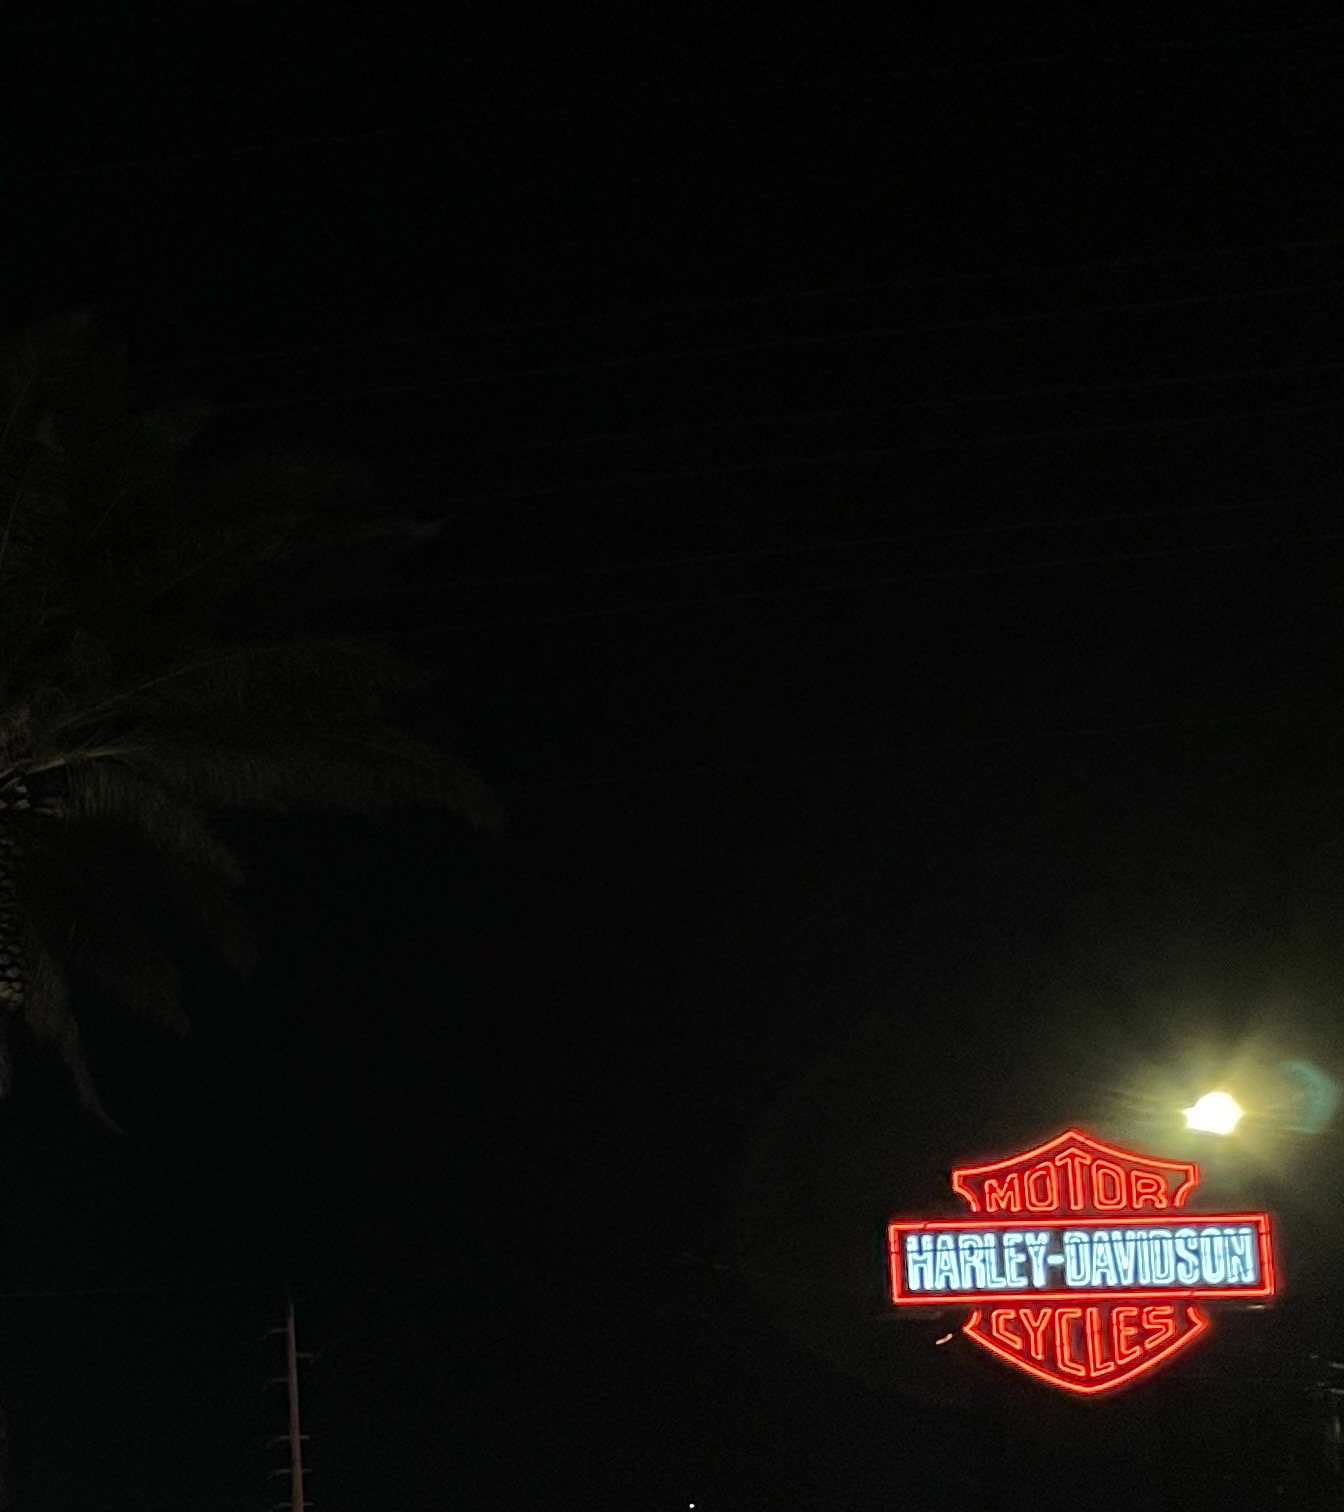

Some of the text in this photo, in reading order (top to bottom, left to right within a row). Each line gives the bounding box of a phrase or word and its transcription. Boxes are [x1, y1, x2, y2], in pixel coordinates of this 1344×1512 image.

[984, 1146, 1169, 1213] MOTOR
[905, 1227, 1256, 1291] HARLEY-DAVIDSON
[990, 1306, 1176, 1378] CYCLES
